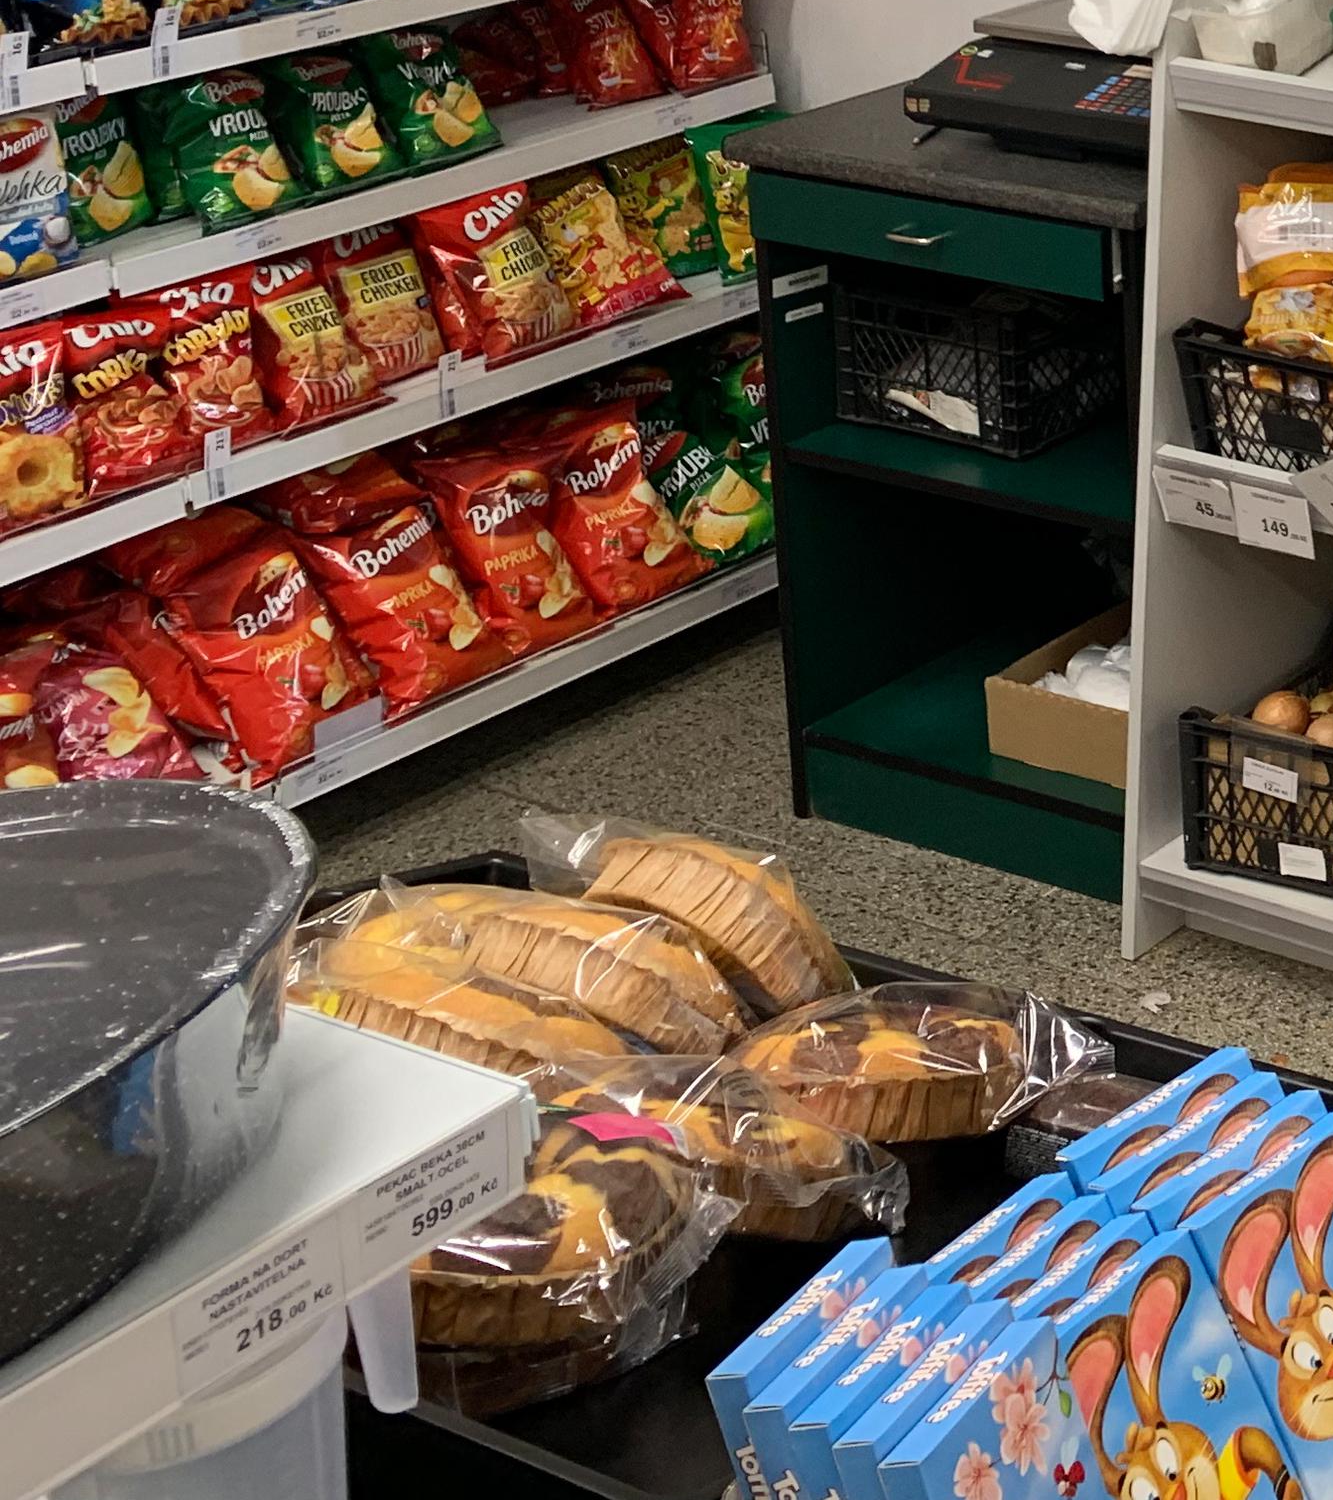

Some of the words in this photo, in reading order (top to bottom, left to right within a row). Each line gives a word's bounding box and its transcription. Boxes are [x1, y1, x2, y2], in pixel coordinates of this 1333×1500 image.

[463, 189, 524, 243] Chio
[359, 261, 406, 288] FRIED
[360, 275, 422, 305] CHICKEN
[484, 544, 539, 576] PAPRIKA
[1106, 1075, 1194, 1129] Toffifee
[420, 1152, 454, 1177] BEKA
[480, 1177, 500, 1199] Kč
[1224, 1139, 1309, 1196] Toffifee
[252, 1262, 271, 1278] NA
[273, 1238, 309, 1269] DORT
[929, 1204, 1018, 1264] Toffifee
[312, 1283, 335, 1304] Kč
[756, 1270, 843, 1338] Toffifee
[1054, 1261, 1139, 1324] Toffifee
[836, 1316, 921, 1386] Toffifee
[926, 1352, 1006, 1424] Toffifee
